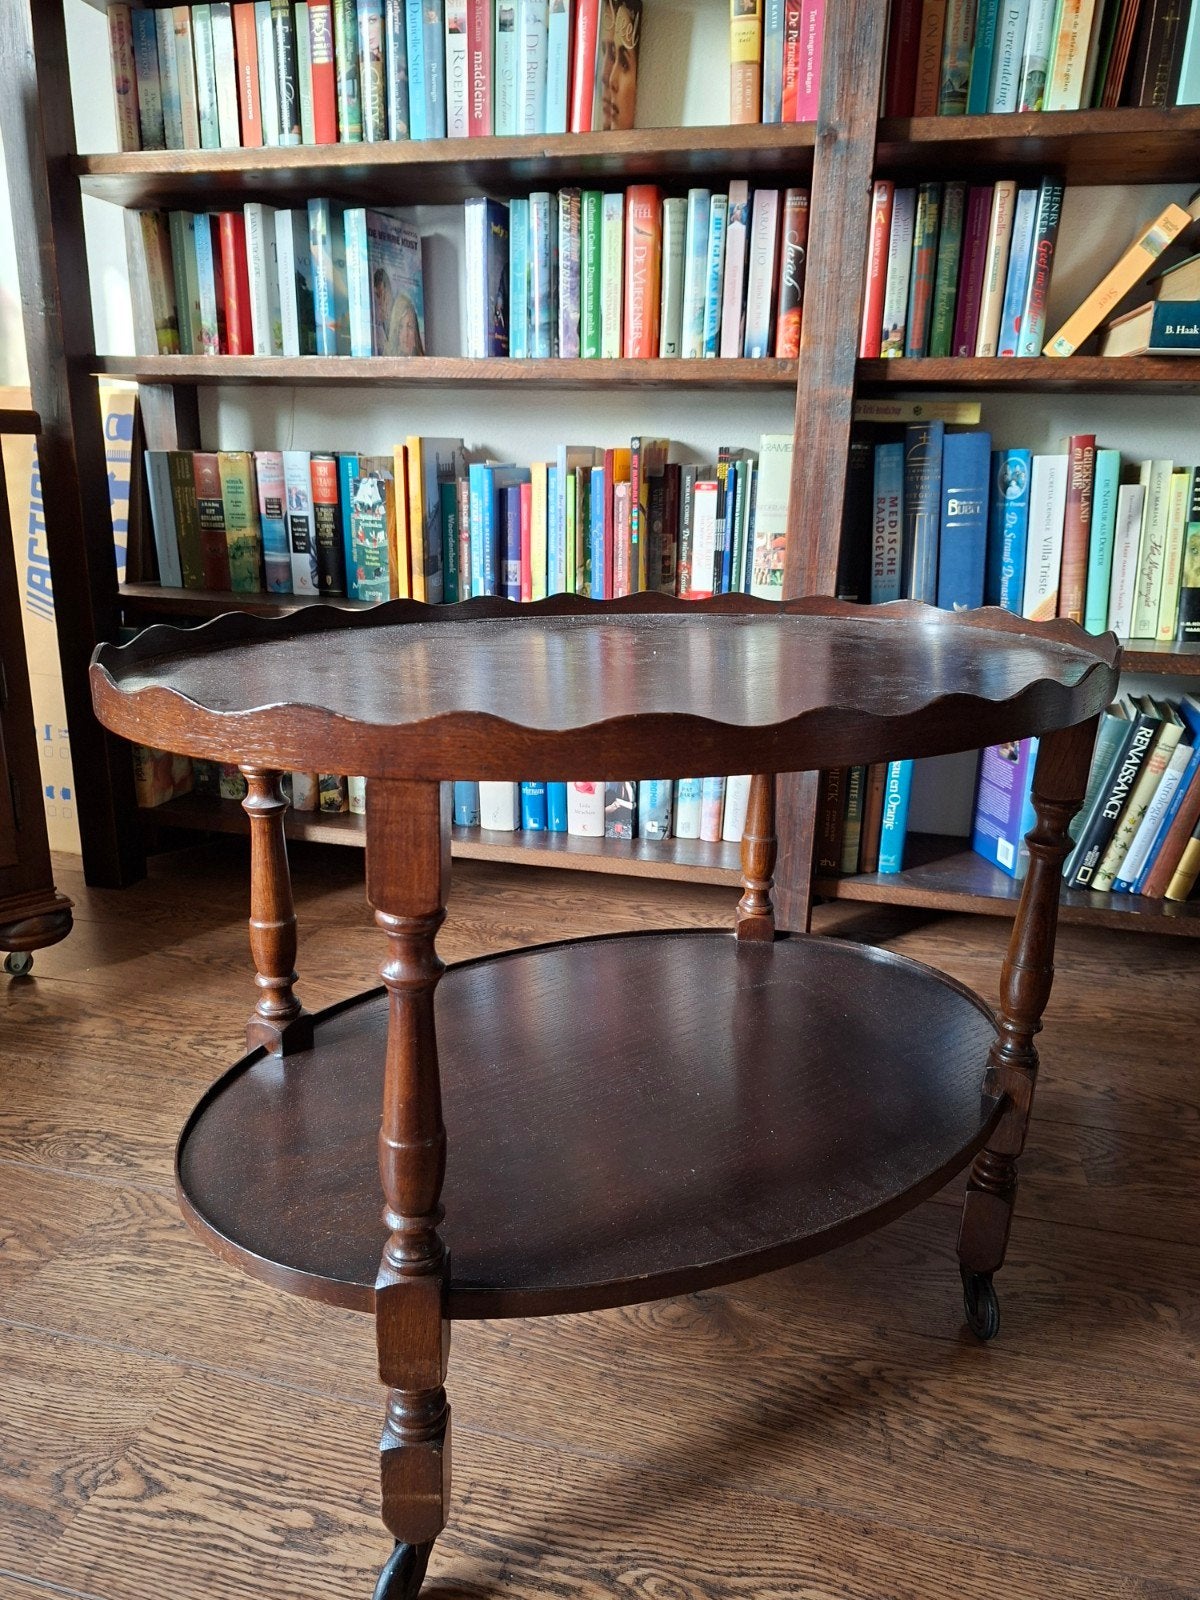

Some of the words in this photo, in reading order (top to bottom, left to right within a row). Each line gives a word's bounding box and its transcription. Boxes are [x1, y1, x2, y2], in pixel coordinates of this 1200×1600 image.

[409, 2, 421, 52] Danielle
[788, 11, 799, 25] De
[809, 9, 818, 22] Tot
[809, 23, 817, 31] in
[1008, 9, 1020, 27] De
[806, 33, 816, 56] lengte
[984, 21, 993, 48] VLUGT
[411, 54, 422, 84] Steel
[787, 30, 799, 89] Petrusakten
[996, 31, 1015, 106] vreemdeling
[453, 49, 465, 129] ROEPING
[474, 51, 485, 119] madeleine
[805, 72, 814, 94] dagen
[1063, 63, 1073, 93] Engelen
[362, 66, 380, 125] CADIX
[588, 197, 596, 232] Catherine
[759, 202, 770, 240] SARAH
[995, 189, 1010, 236] Daniella
[1039, 186, 1053, 233] DENKER
[1048, 186, 1062, 228] HENRY
[588, 233, 596, 264] Cookson
[633, 246, 647, 266] DE
[757, 246, 767, 265] JIO
[873, 227, 882, 256] GRAVIN
[1038, 239, 1053, 267] Geef
[586, 266, 595, 293] Dagen
[783, 230, 805, 302] Sarah
[1036, 271, 1046, 286] me
[632, 270, 647, 340] VLIEGENIER
[1034, 288, 1045, 298] je
[586, 312, 595, 337] geluk
[1165, 325, 1174, 334] B.
[1175, 325, 1199, 334] Haak
[761, 443, 793, 453] KRAME
[1074, 447, 1082, 459] en
[1080, 446, 1094, 523] GRIEKENLAND
[1104, 479, 1111, 487] DE
[1155, 472, 1163, 494] SCOTT
[1005, 513, 1018, 528] De
[1101, 490, 1112, 522] NATUUR
[1152, 496, 1161, 527] MARIANI
[447, 514, 456, 574] Woordenboek
[682, 529, 690, 540] De
[874, 497, 886, 577] RAADGEVER
[886, 496, 899, 576] MEDISCHE
[1003, 530, 1017, 563] Strauß
[1041, 536, 1053, 561] Villa
[681, 542, 689, 567] nieuwe
[1097, 537, 1107, 566] DOKTER
[680, 568, 689, 594] Messias
[1000, 566, 1015, 609] Dynastie
[1038, 563, 1051, 595] Triste
[849, 771, 860, 799] WITTE
[890, 780, 900, 793] en
[1102, 725, 1155, 820] RENAISSANCE
[847, 801, 857, 817] HEL
[884, 794, 901, 831] Oranje
[1147, 772, 1178, 825] Astrologie
